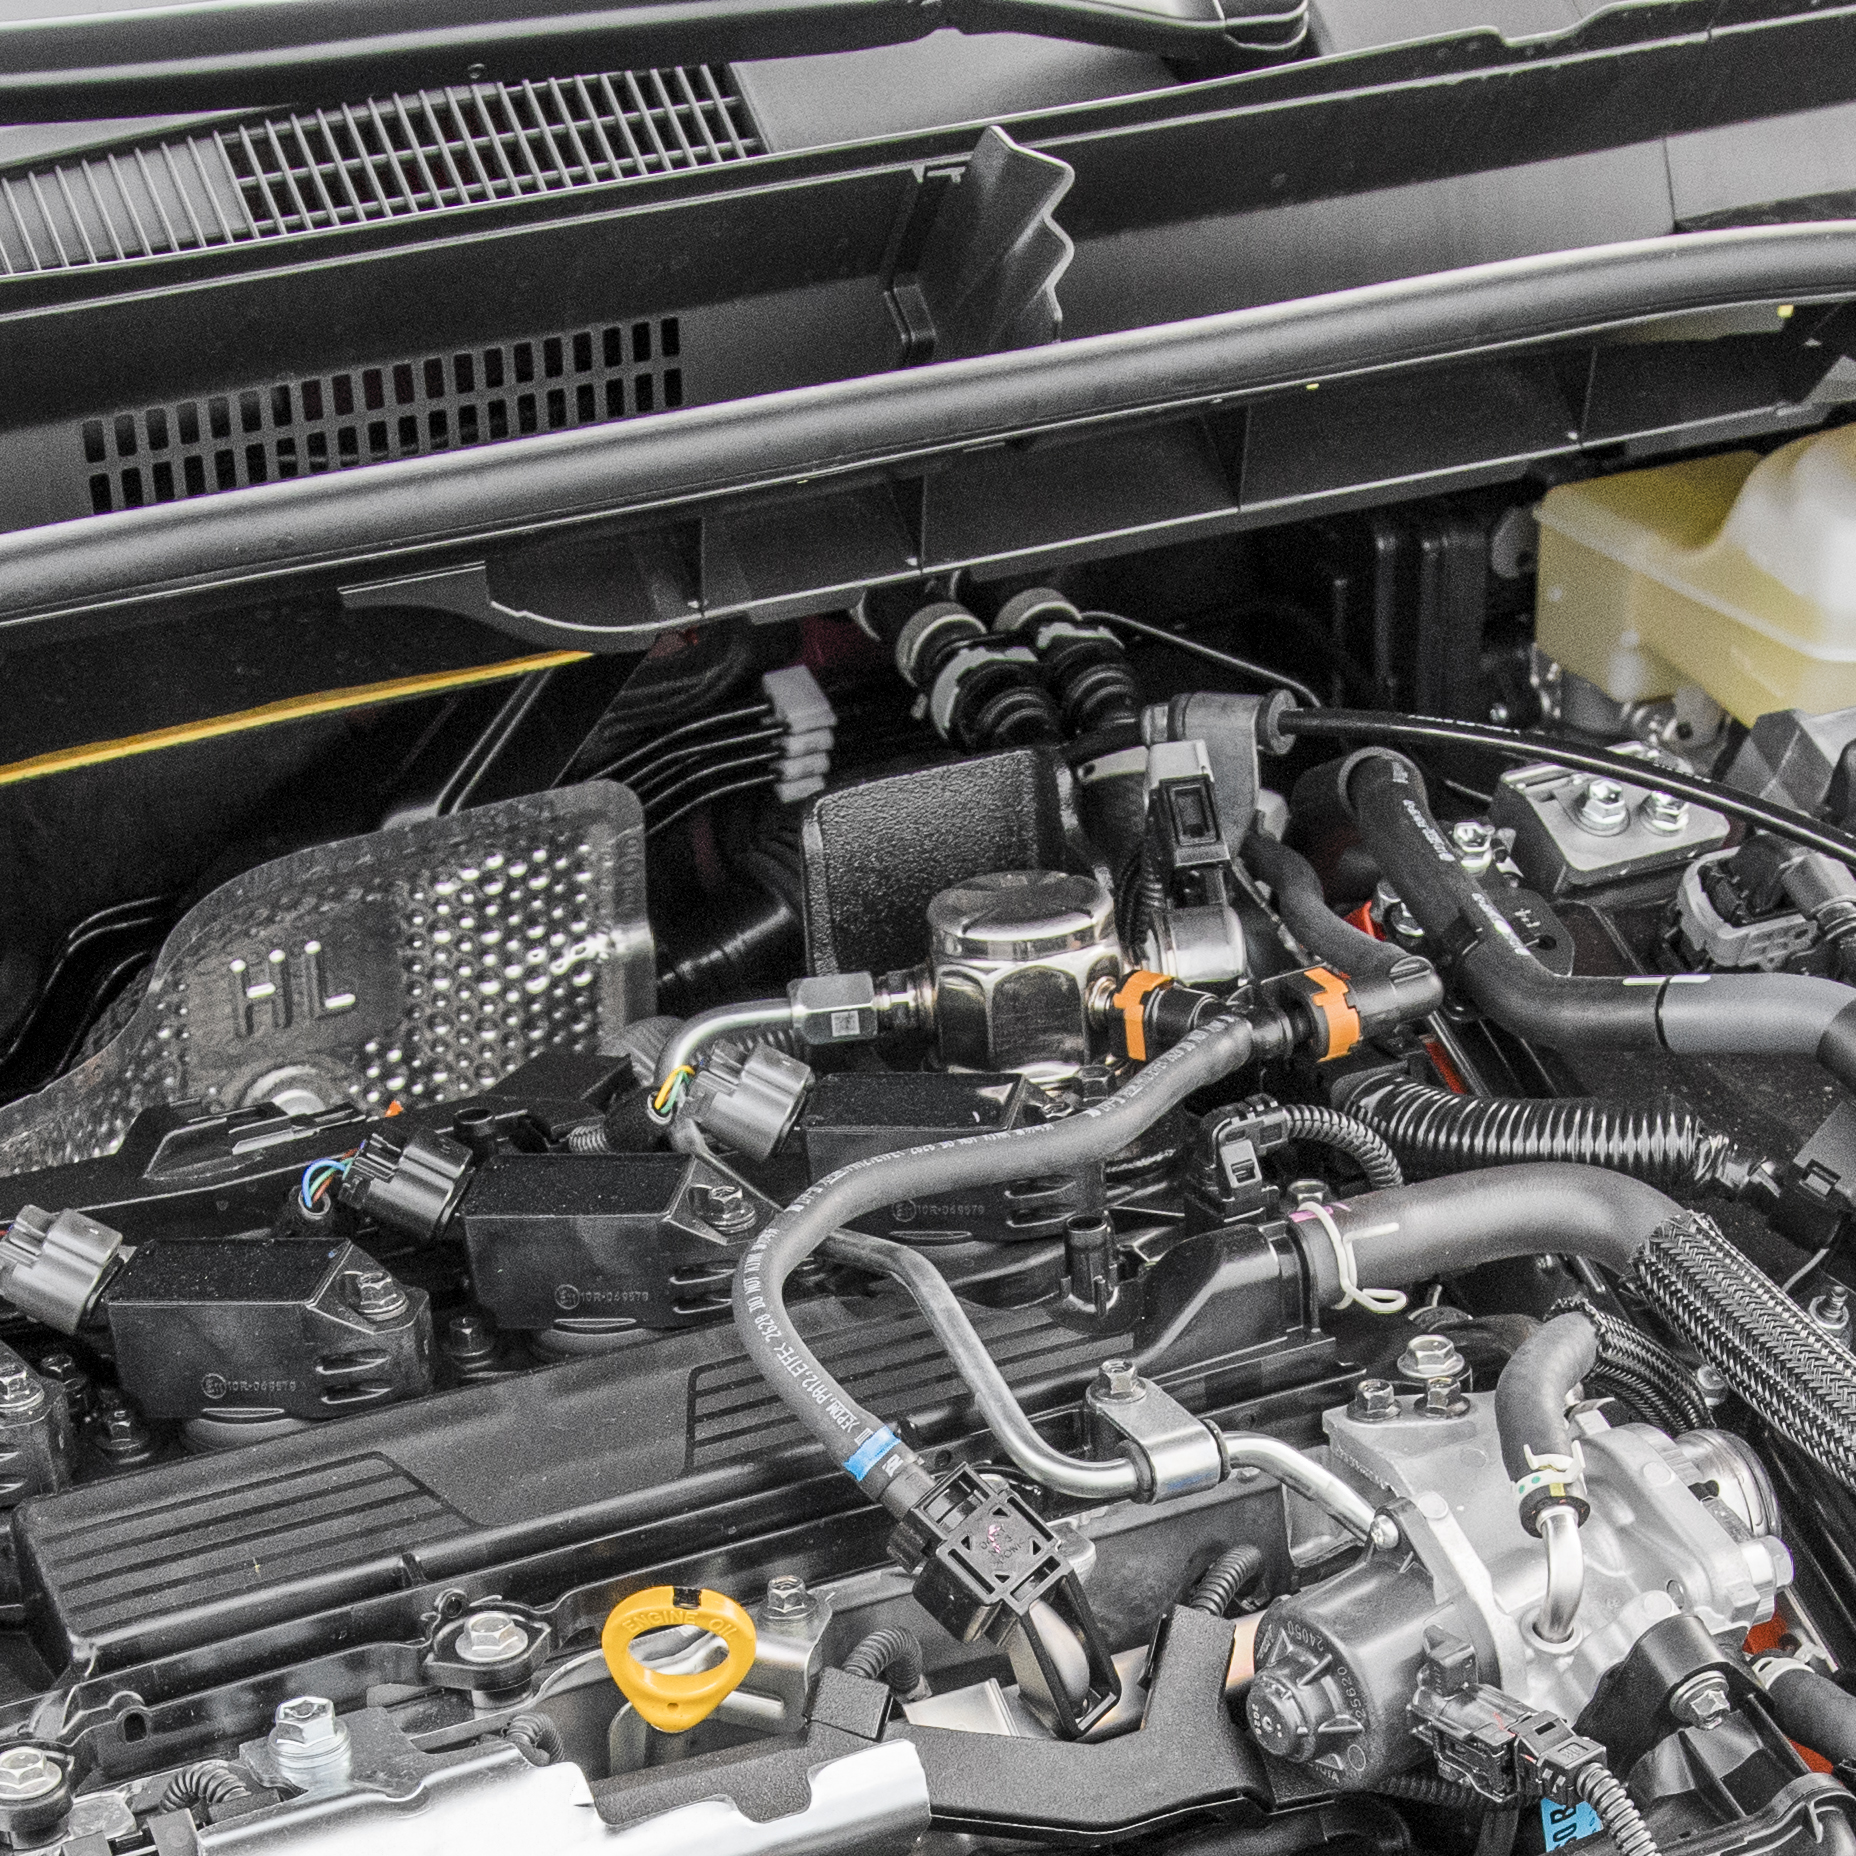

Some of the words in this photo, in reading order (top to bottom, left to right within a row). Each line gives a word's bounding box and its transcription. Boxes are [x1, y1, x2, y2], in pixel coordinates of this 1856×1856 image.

[230, 940, 356, 1038] HL
[622, 1611, 698, 1633] ENGINE
[708, 1618, 737, 1640] OIL
